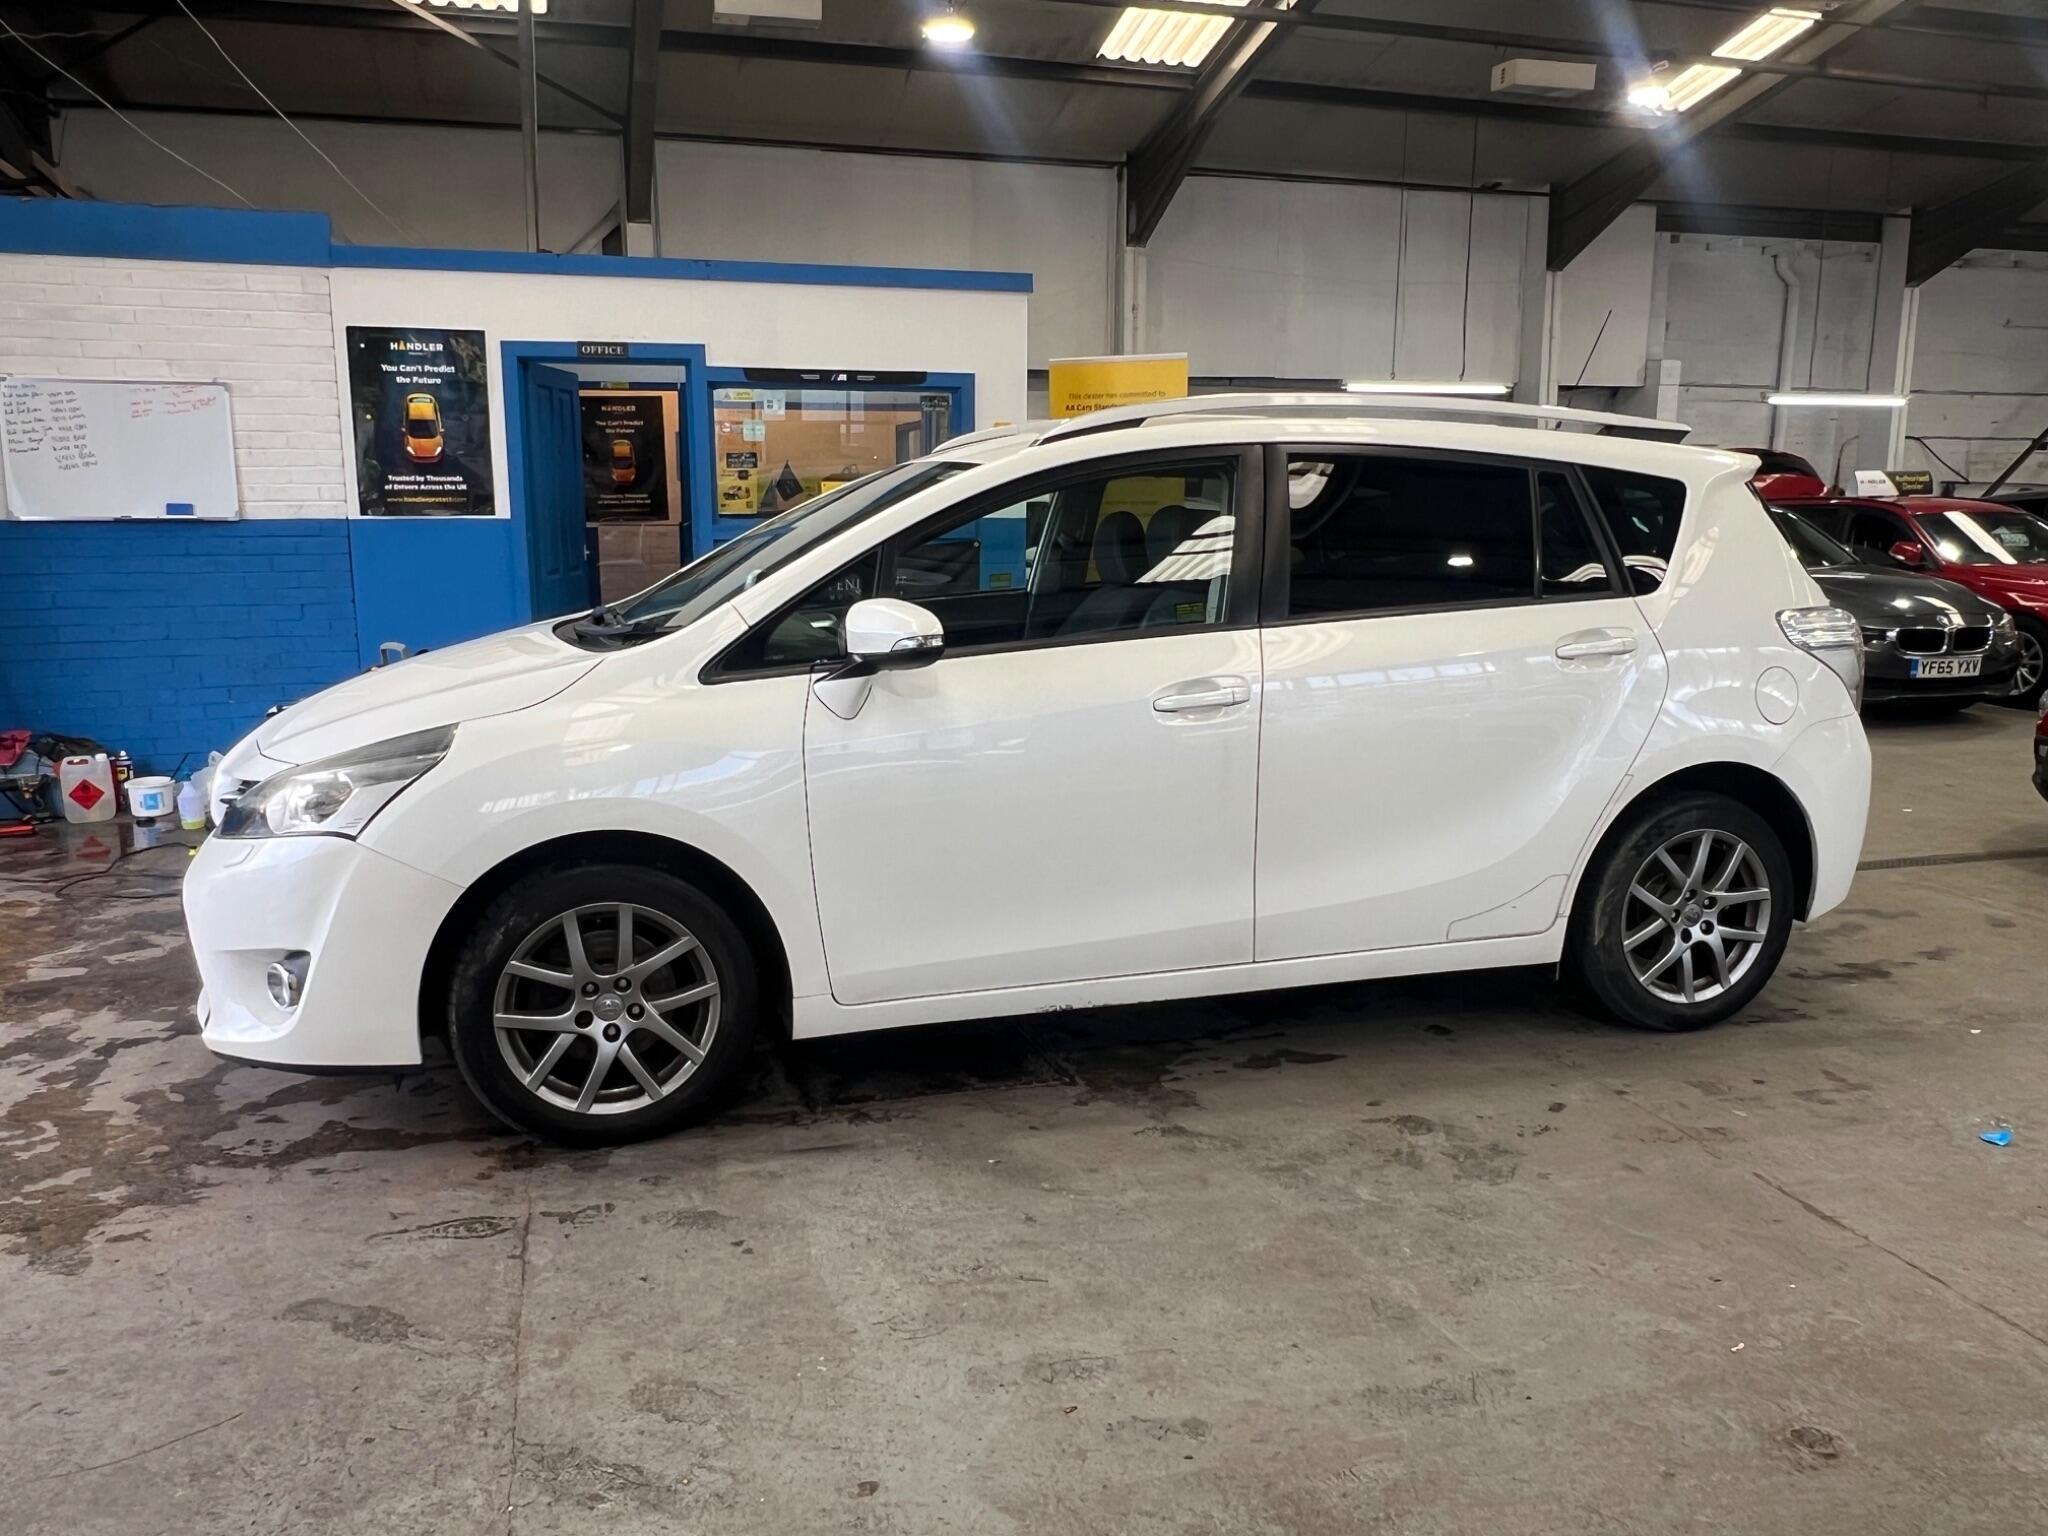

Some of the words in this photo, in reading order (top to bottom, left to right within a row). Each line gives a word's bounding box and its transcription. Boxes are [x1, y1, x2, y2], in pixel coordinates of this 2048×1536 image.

[390, 340, 444, 351] HANDLER
[582, 345, 624, 354] OFFICE
[381, 363, 398, 372] You
[400, 364, 422, 372] Can't
[424, 364, 456, 373] Predict
[396, 376, 411, 384] the
[413, 376, 442, 384] Future
[1119, 390, 1157, 399] committed
[1159, 390, 1167, 398] to
[1077, 403, 1092, 411] Cars
[388, 474, 415, 482] Trusted
[426, 474, 463, 482] Thousands
[1922, 660, 1953, 674] YF65
[1957, 660, 1979, 673] YXV
